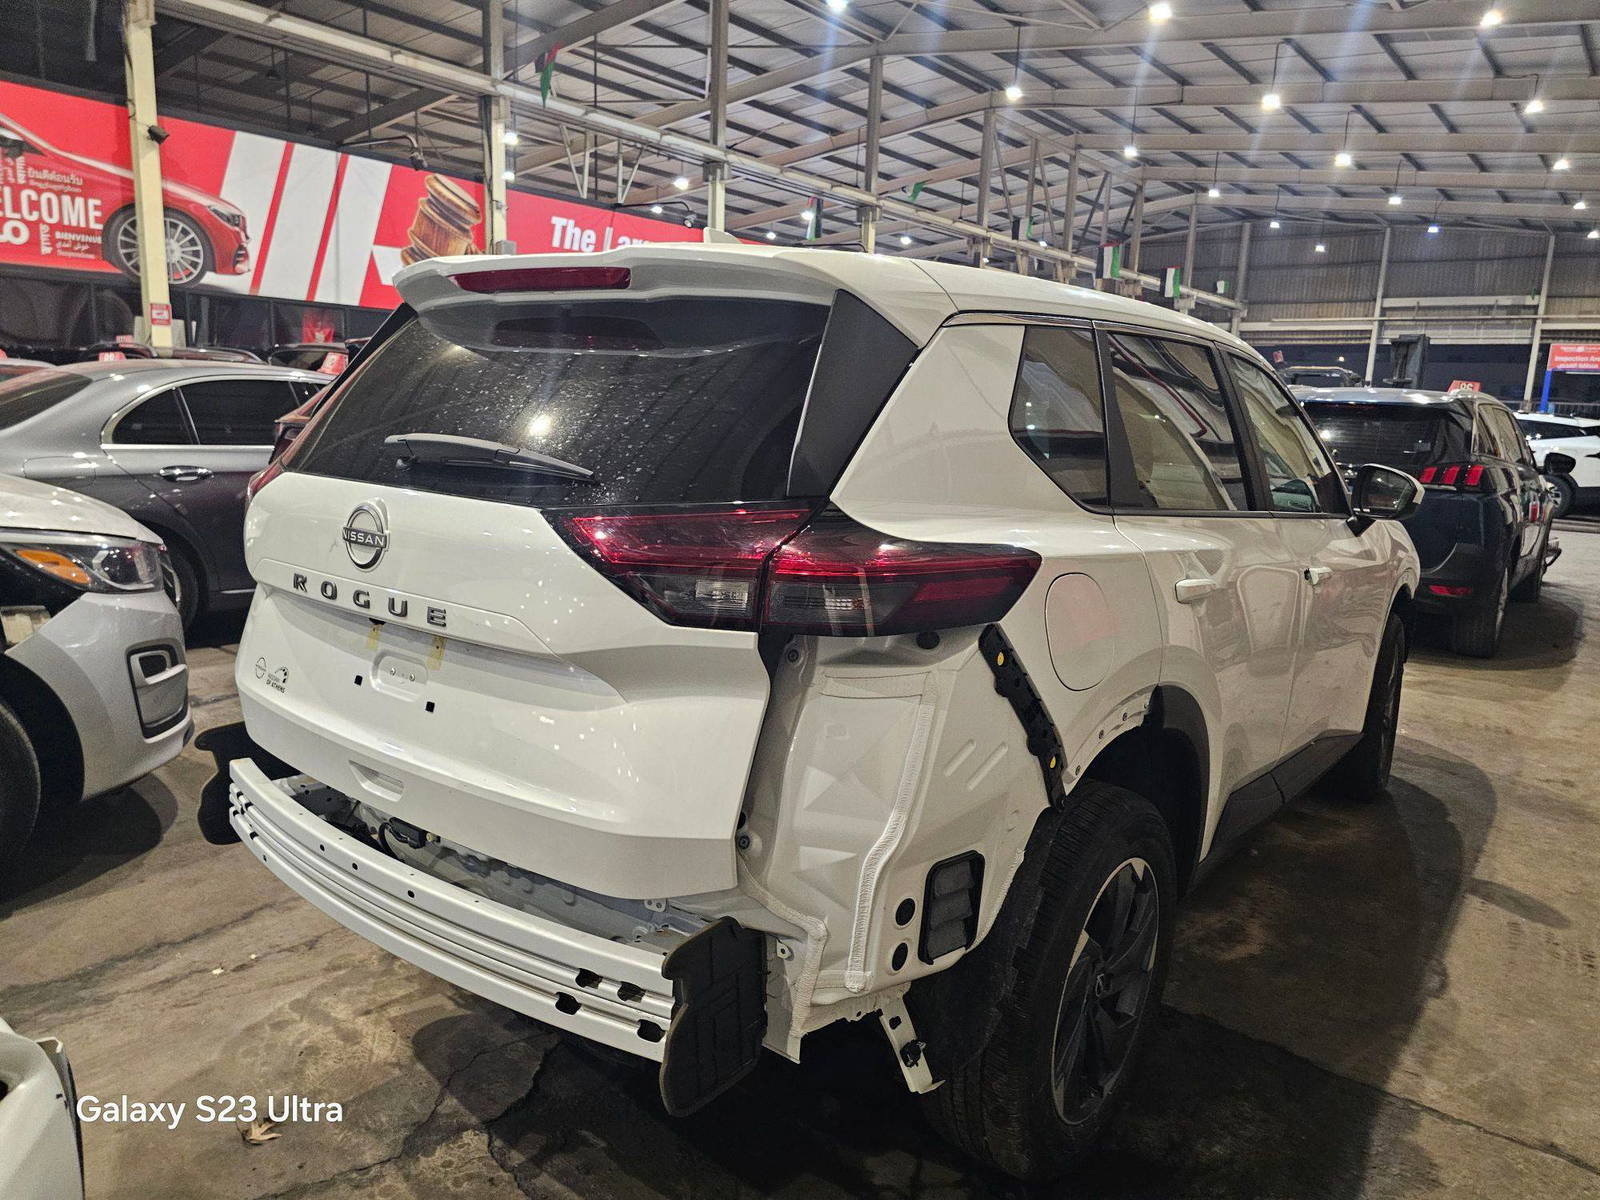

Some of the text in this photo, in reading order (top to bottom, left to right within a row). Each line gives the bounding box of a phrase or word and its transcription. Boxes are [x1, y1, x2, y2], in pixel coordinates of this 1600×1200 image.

[551, 216, 596, 253] The
[342, 529, 385, 547] NISSAN
[293, 573, 447, 627] ROGUE
